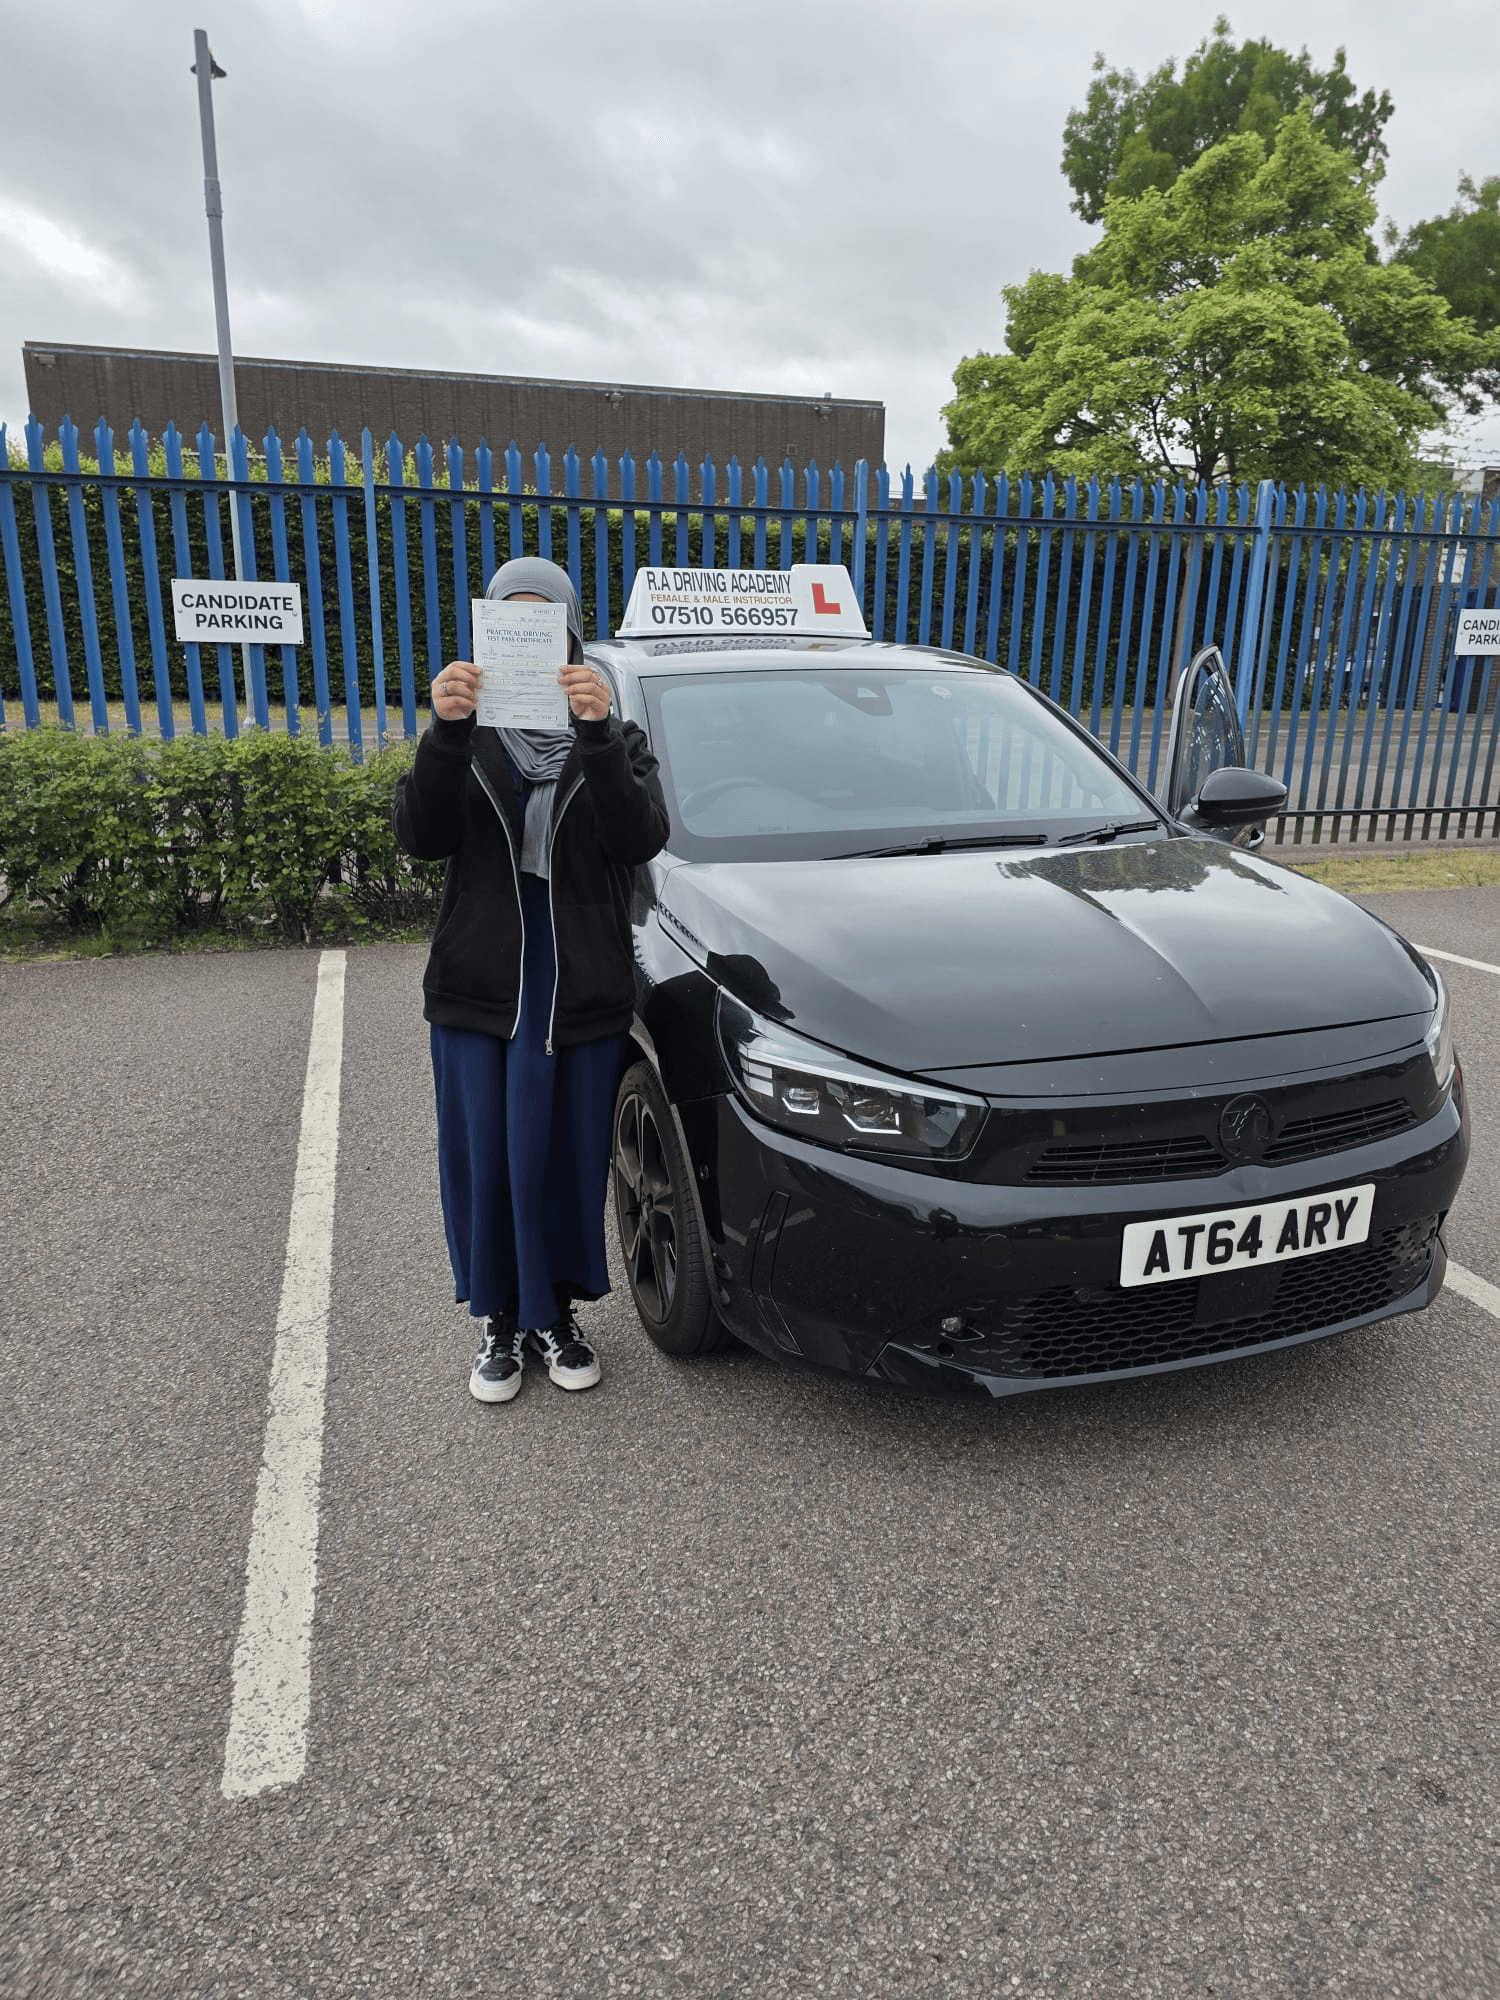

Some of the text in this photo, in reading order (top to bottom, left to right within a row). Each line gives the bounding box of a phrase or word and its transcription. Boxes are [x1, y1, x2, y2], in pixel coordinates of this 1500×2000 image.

[646, 571, 791, 594] R.A DRIVING ACADEMY
[181, 593, 294, 611] CANDIDATE
[651, 594, 793, 605] FEMALE & MALE INSTRUCTOR
[811, 583, 841, 614] L
[195, 613, 283, 630] PARKING
[651, 605, 798, 626] 07510 566957
[523, 630, 552, 638] DRIVING
[1143, 1196, 1359, 1276] AT64 ARY
